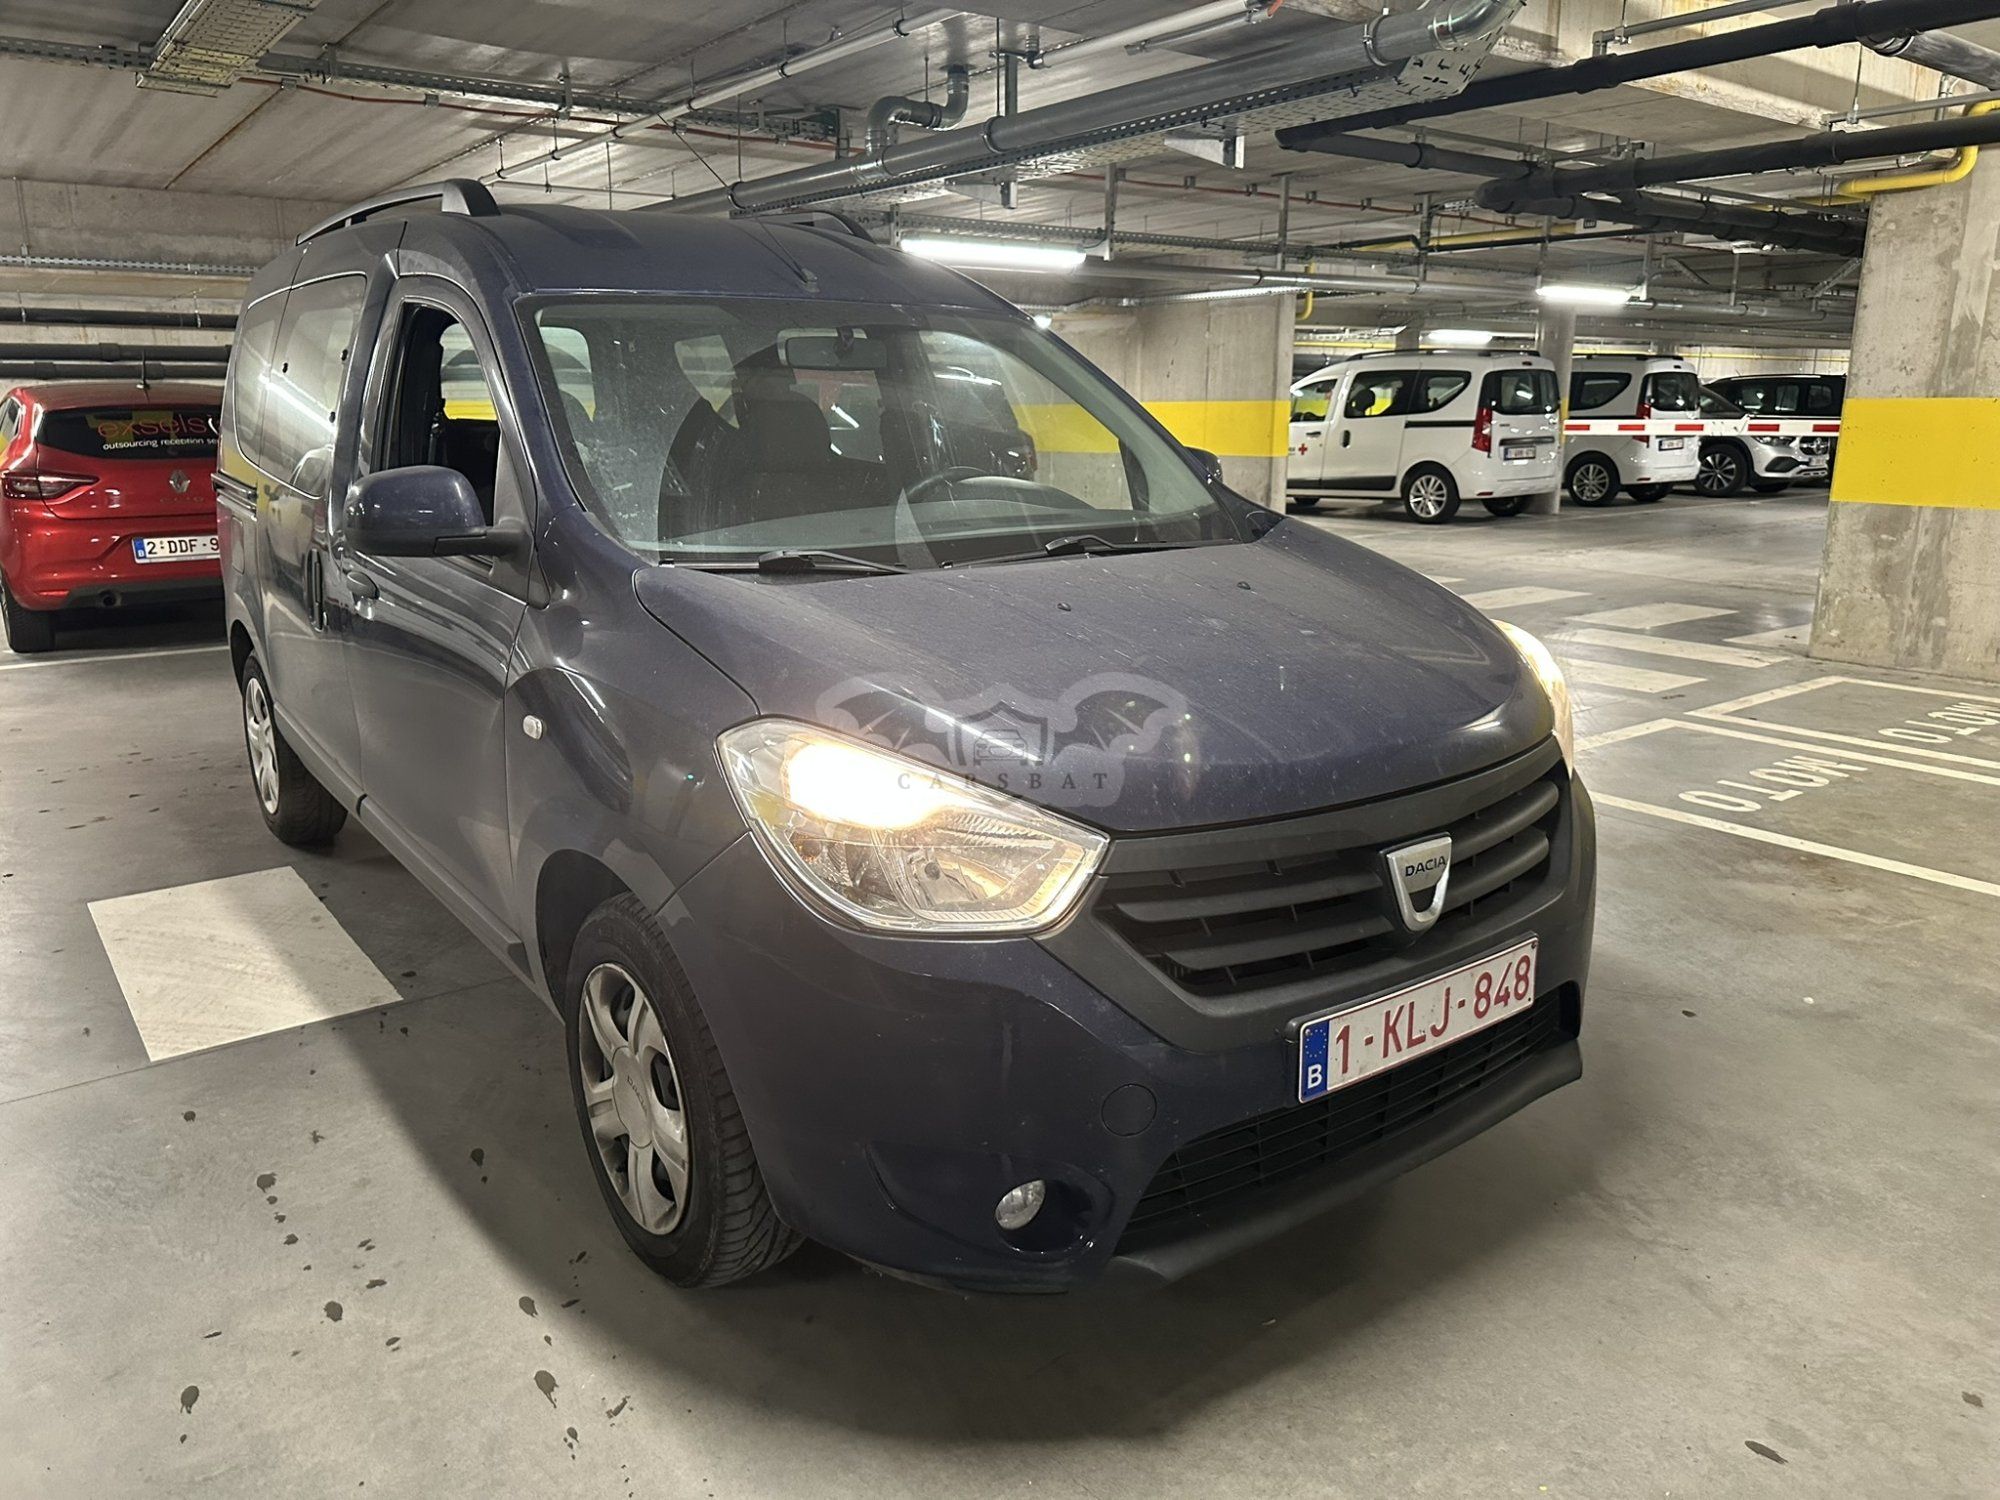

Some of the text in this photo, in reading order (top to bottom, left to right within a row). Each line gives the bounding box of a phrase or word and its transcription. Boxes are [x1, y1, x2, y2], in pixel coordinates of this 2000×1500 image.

[102, 439, 159, 451] outsourcing
[1678, 755, 1868, 813] MOTO
[1404, 855, 1447, 877] DACIA
[1307, 954, 1531, 1090] B 1-KLJ-848
